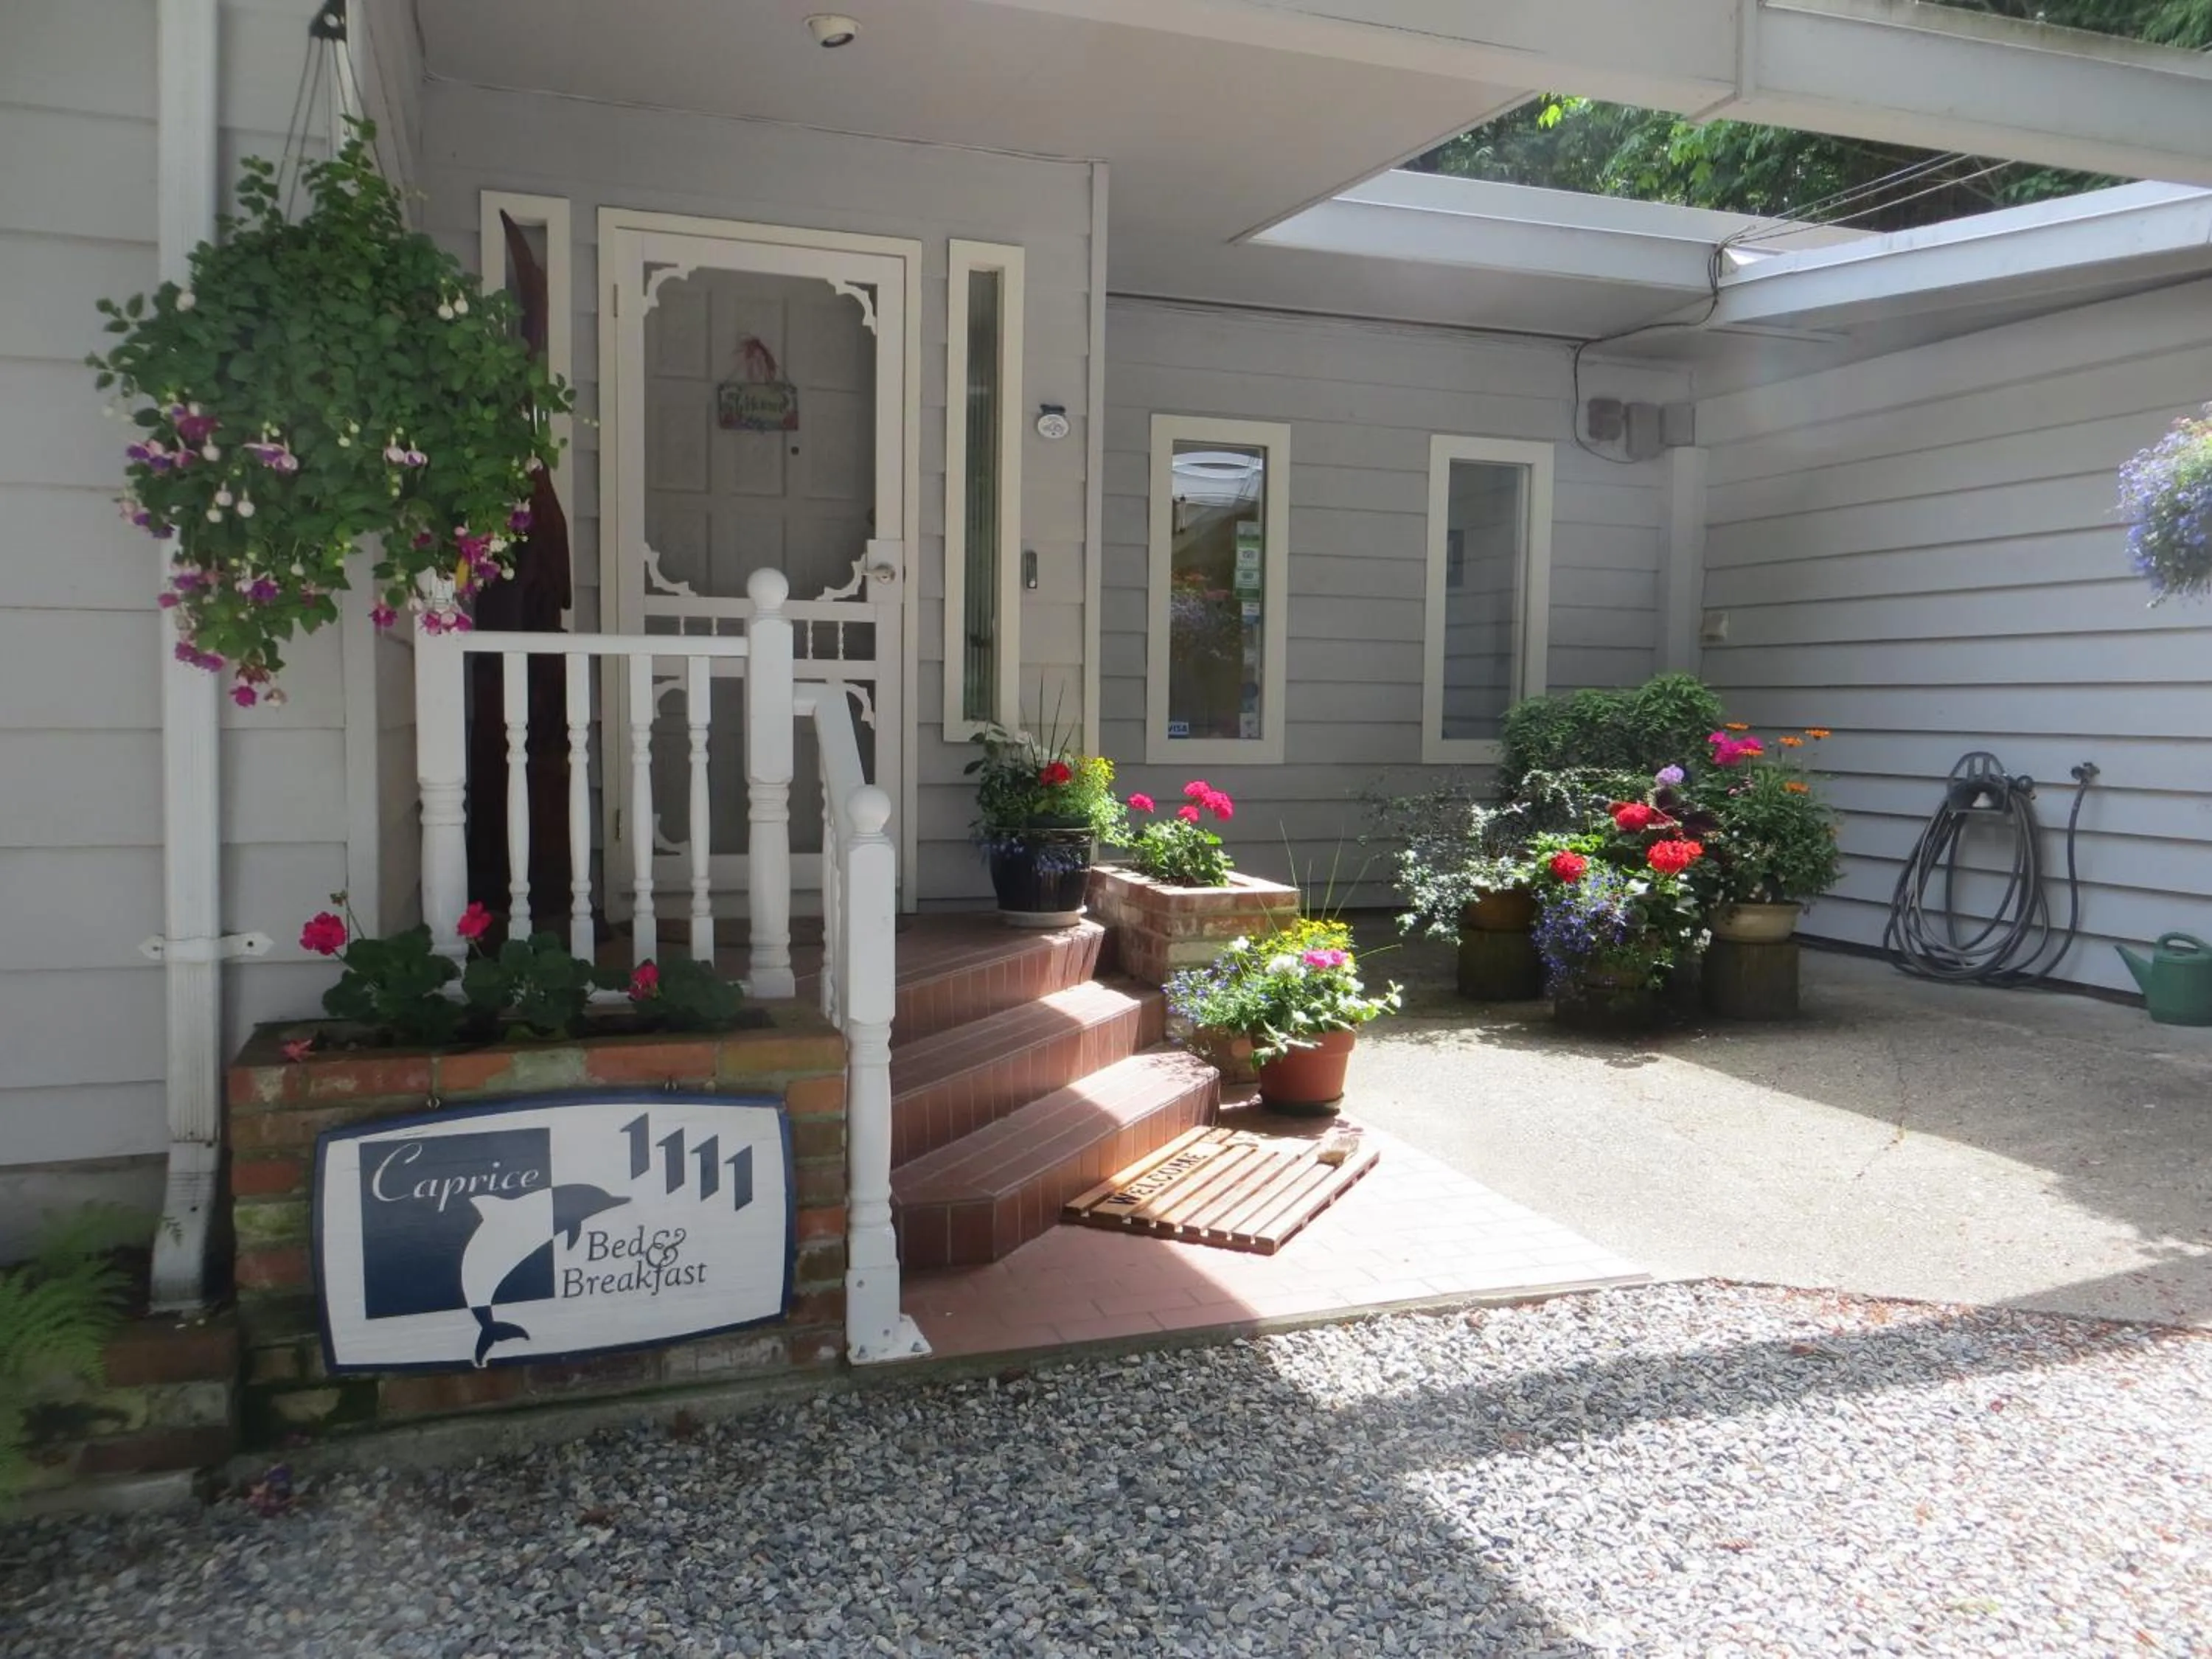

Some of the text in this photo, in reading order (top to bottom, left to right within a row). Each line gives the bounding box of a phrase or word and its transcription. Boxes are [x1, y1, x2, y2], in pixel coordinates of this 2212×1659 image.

[372, 1142, 540, 1213] Caprice
[620, 1112, 754, 1212] 1111
[1107, 1152, 1208, 1205] WELCOME
[588, 1225, 645, 1262] Bed
[563, 1259, 707, 1299] Breakfast
